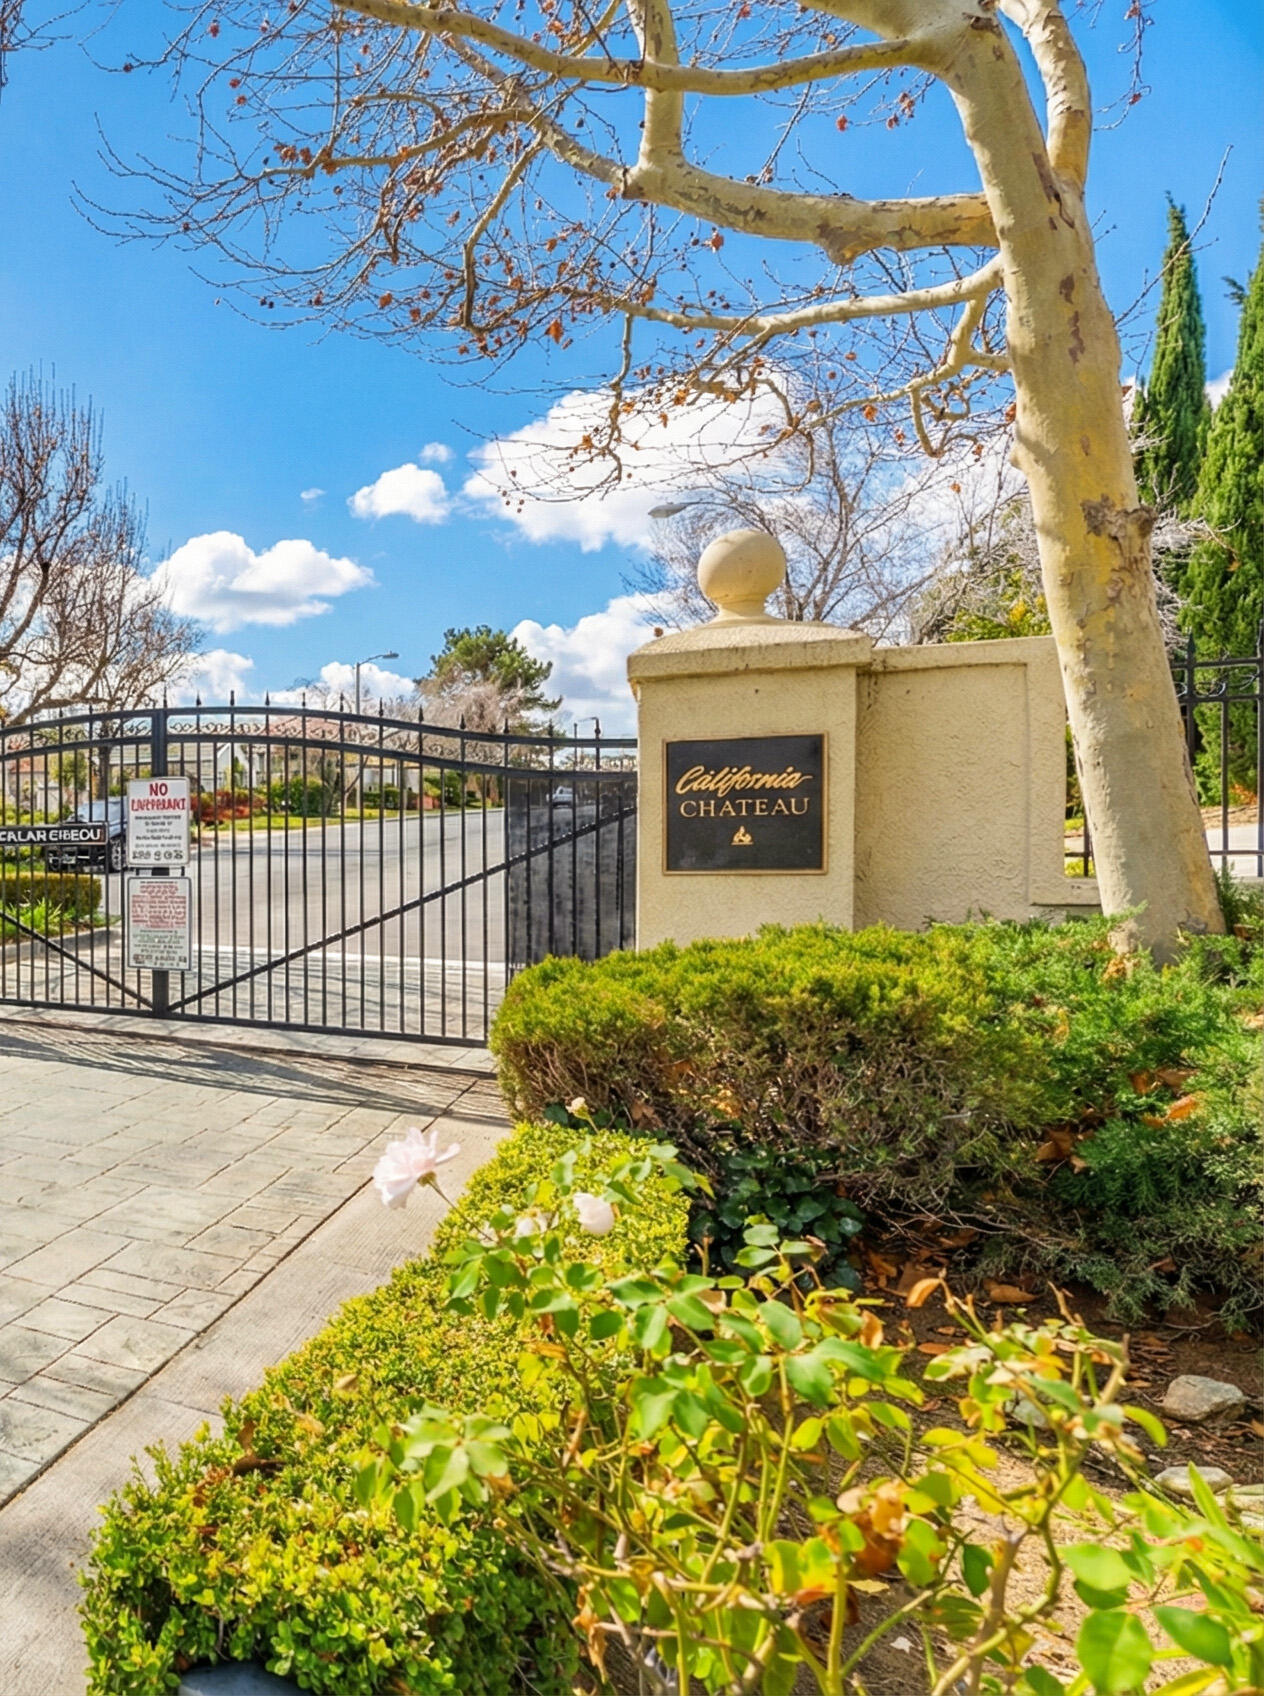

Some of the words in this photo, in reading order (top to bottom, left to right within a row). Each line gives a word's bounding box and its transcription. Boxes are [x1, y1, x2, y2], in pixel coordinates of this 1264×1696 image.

[149, 782, 168, 796] NO
[675, 765, 813, 797] California
[680, 797, 809, 817] CHATEAU
